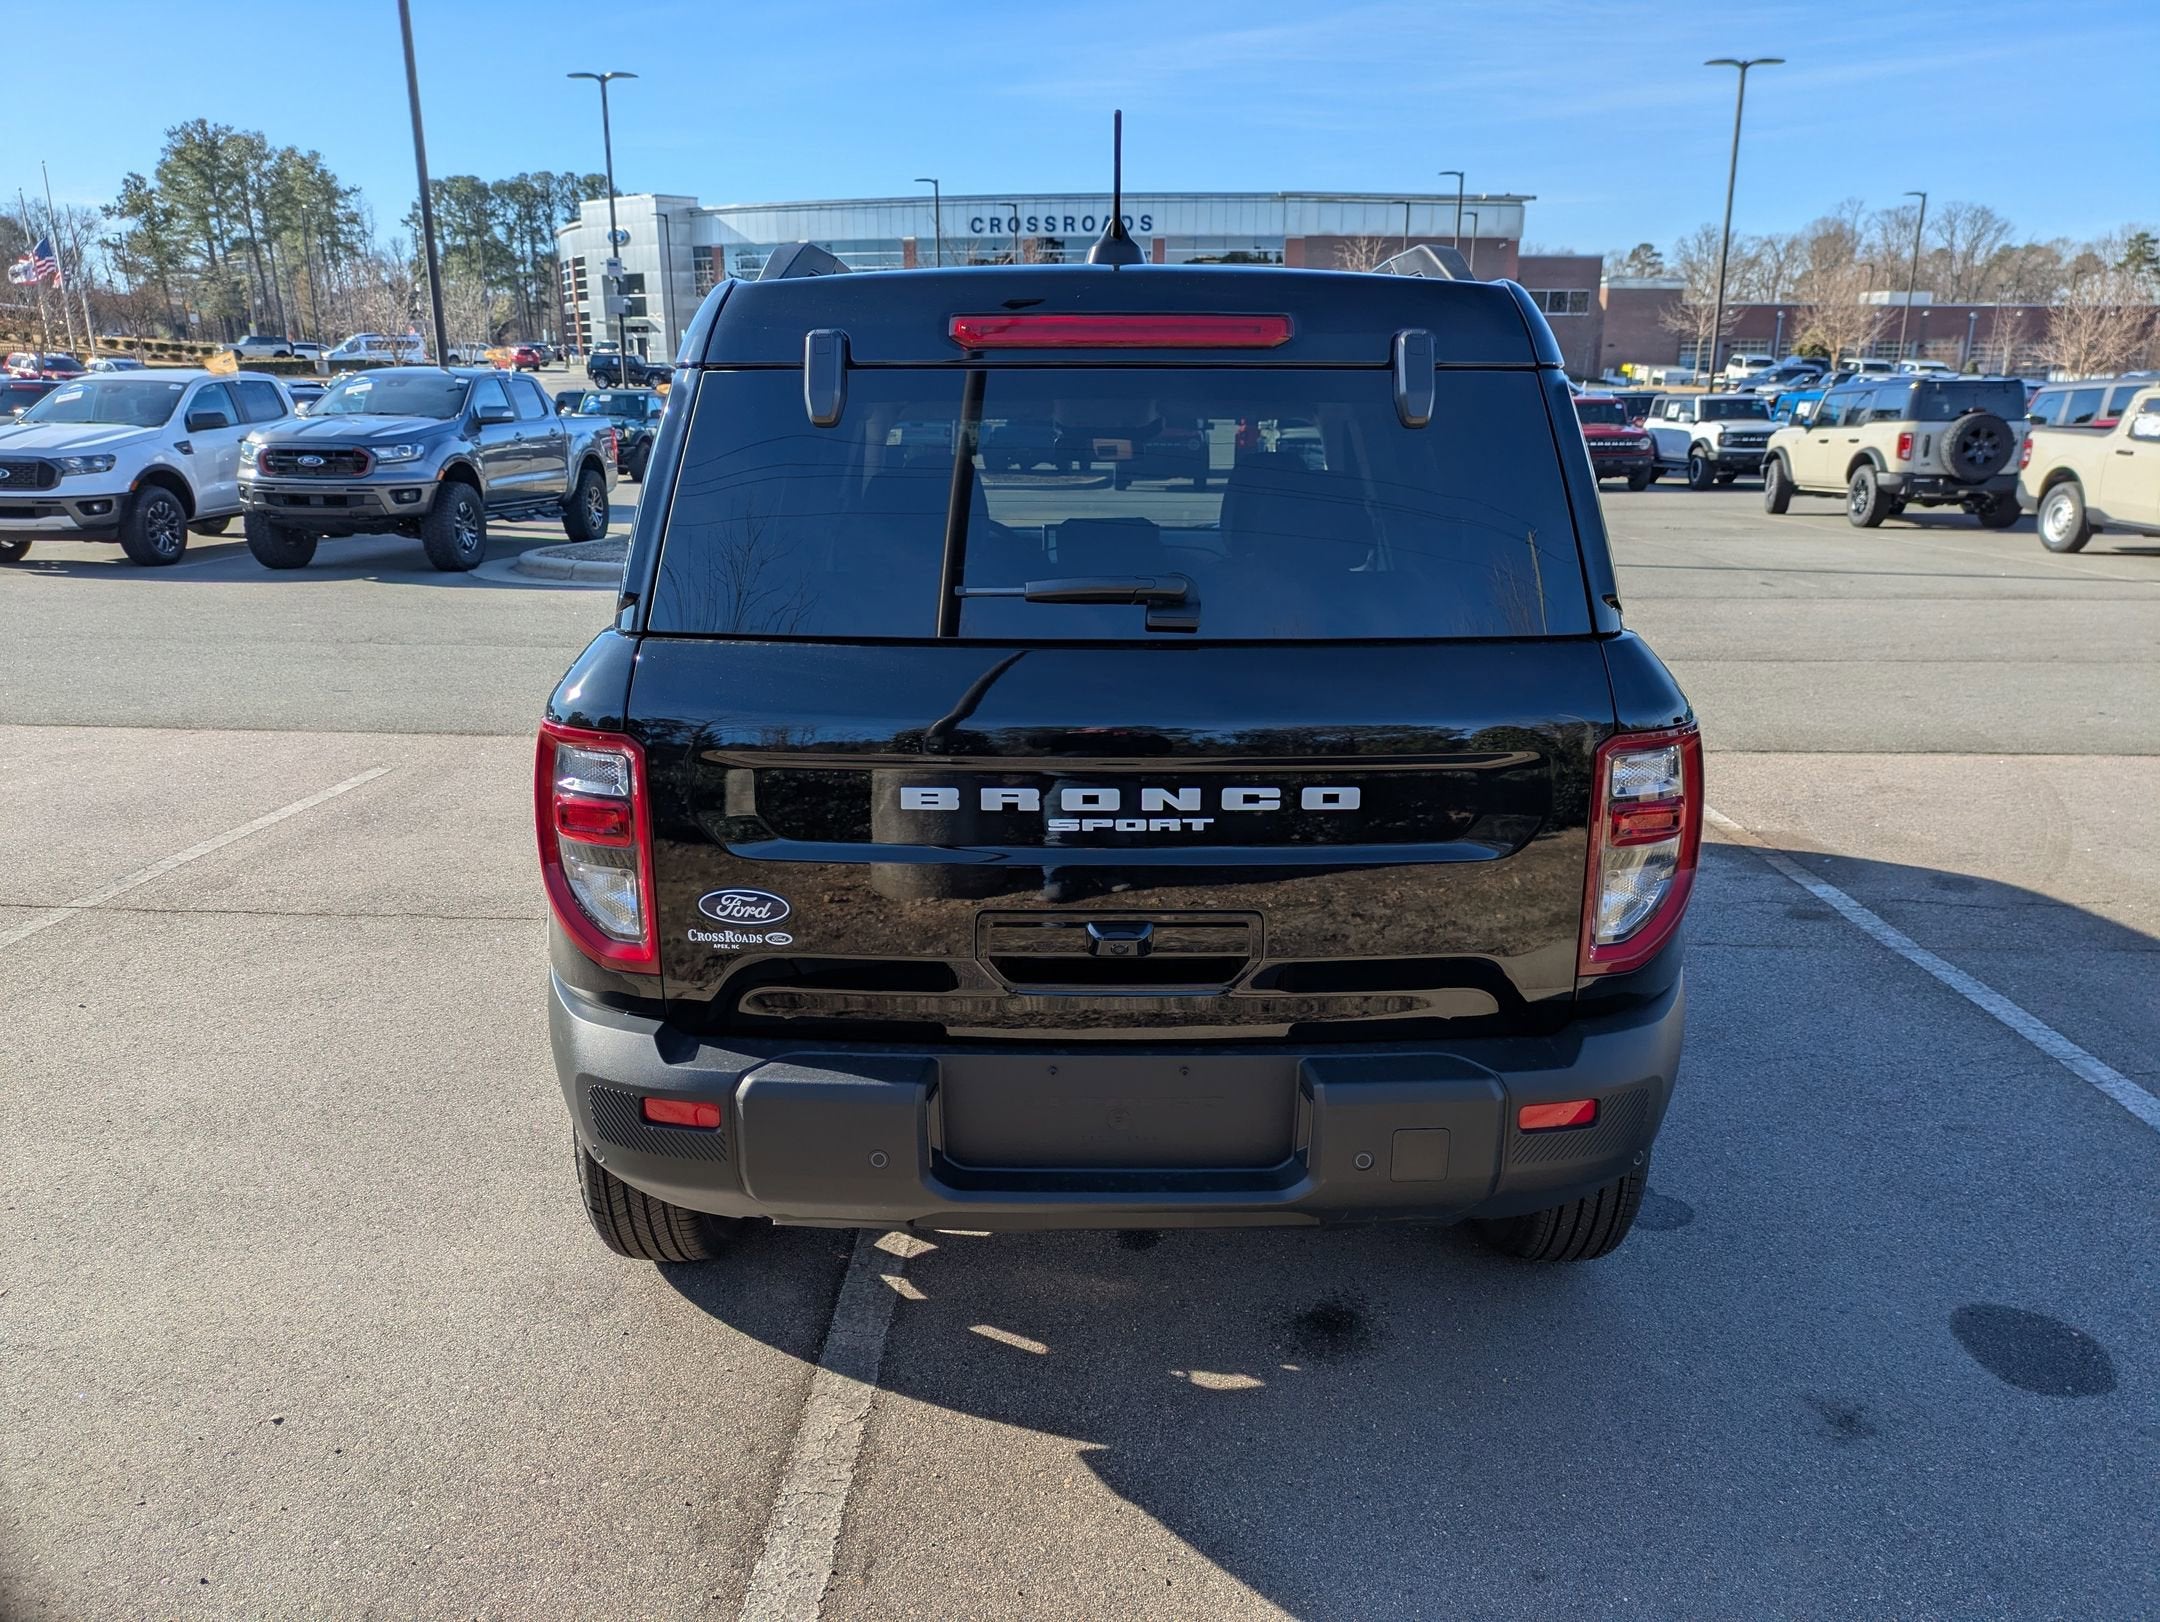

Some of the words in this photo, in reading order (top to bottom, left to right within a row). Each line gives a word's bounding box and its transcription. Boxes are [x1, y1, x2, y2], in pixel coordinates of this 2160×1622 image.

[900, 787, 1360, 811] BRONCO
[1048, 818, 1214, 832] SPORT
[716, 894, 772, 918] Ford
